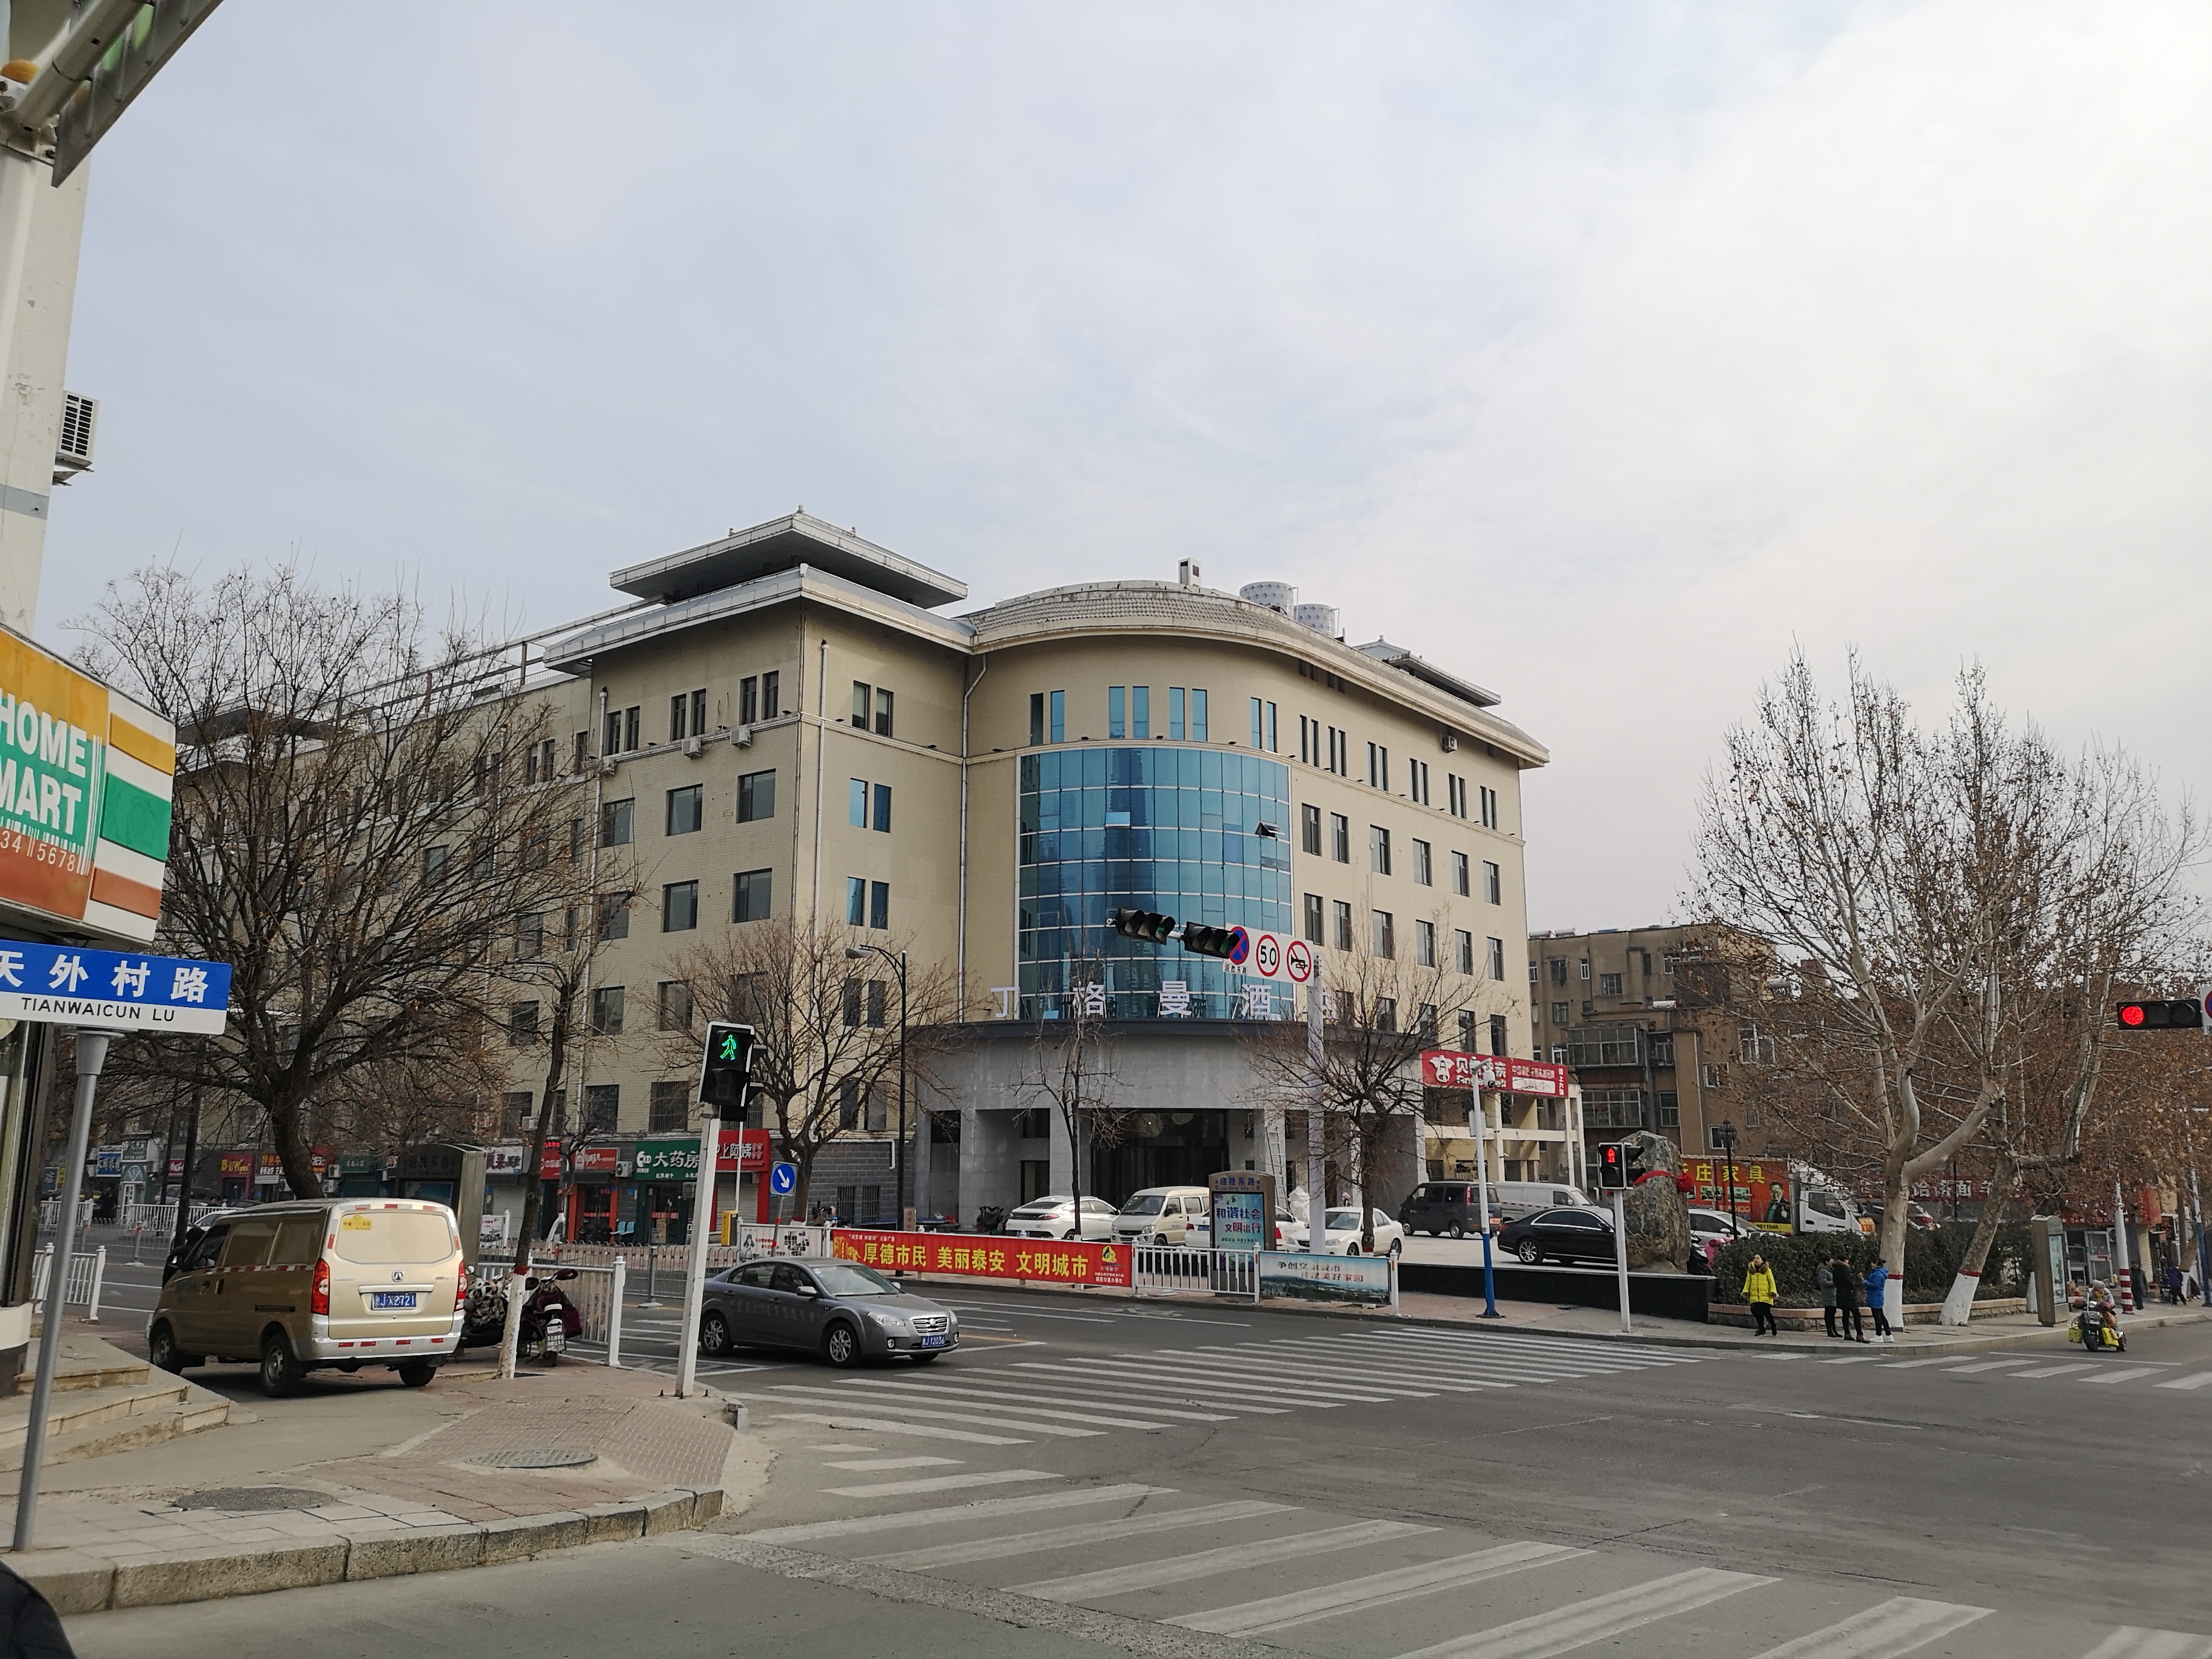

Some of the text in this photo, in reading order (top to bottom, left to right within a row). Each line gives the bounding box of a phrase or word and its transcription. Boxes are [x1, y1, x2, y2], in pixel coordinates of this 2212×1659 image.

[0, 688, 87, 778] HOME
[0, 756, 82, 835] MART
[37, 843, 76, 872] 5678
[1260, 945, 1277, 966] 50
[0, 950, 209, 1004] 天外村路
[22, 997, 175, 1022] TIANWAICUN LU
[652, 1150, 699, 1169] 大药房
[1683, 1162, 1766, 1184] 庄家具
[1216, 1206, 1261, 1220] 和谐社会
[1225, 1222, 1261, 1234] 文明出行
[863, 1242, 1089, 1278] 厚德市民 美丽泰安 文明城市
